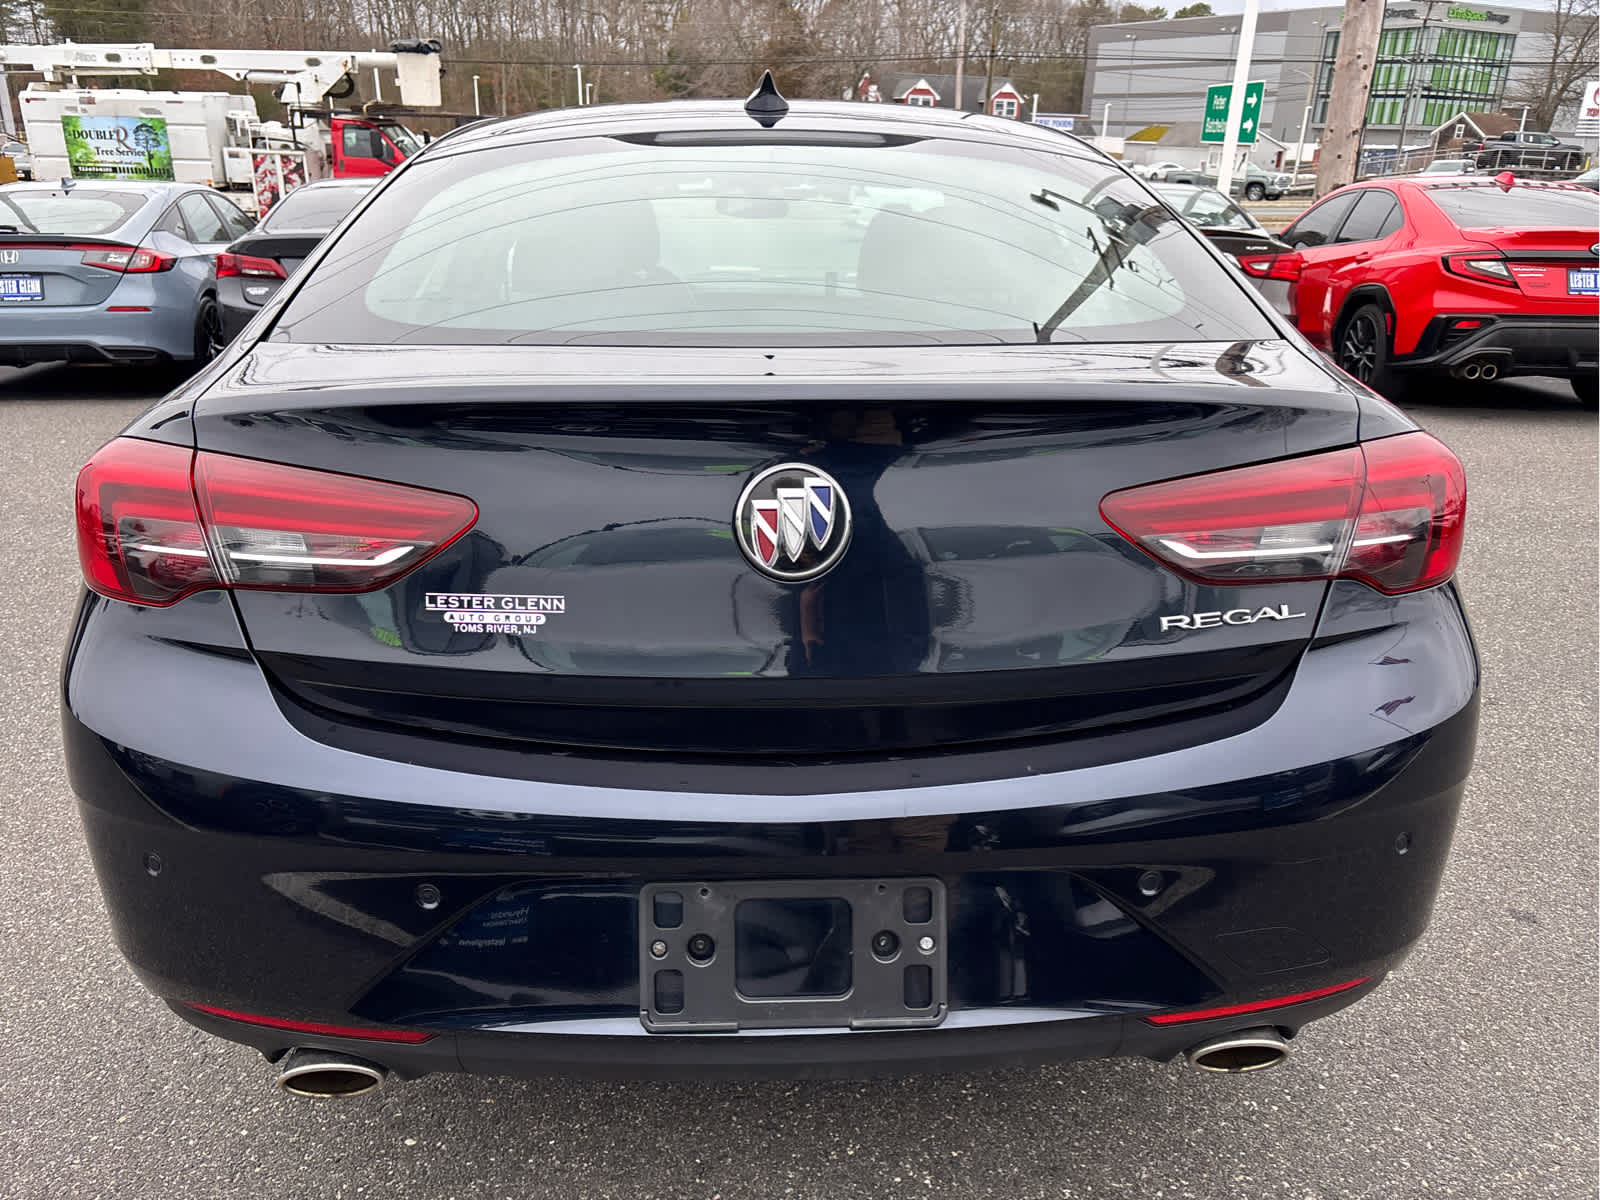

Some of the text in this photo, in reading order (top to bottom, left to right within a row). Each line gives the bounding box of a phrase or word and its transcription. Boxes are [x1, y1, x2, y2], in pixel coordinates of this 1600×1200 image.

[73, 126, 137, 151] DOUBLE R
[95, 146, 147, 157] Tree Service
[425, 595, 566, 610] LESTER GLENN
[447, 613, 542, 623] AUTO GROUP
[1159, 604, 1307, 633] REGAL
[453, 623, 537, 635] TOMS RIVER, NJ
